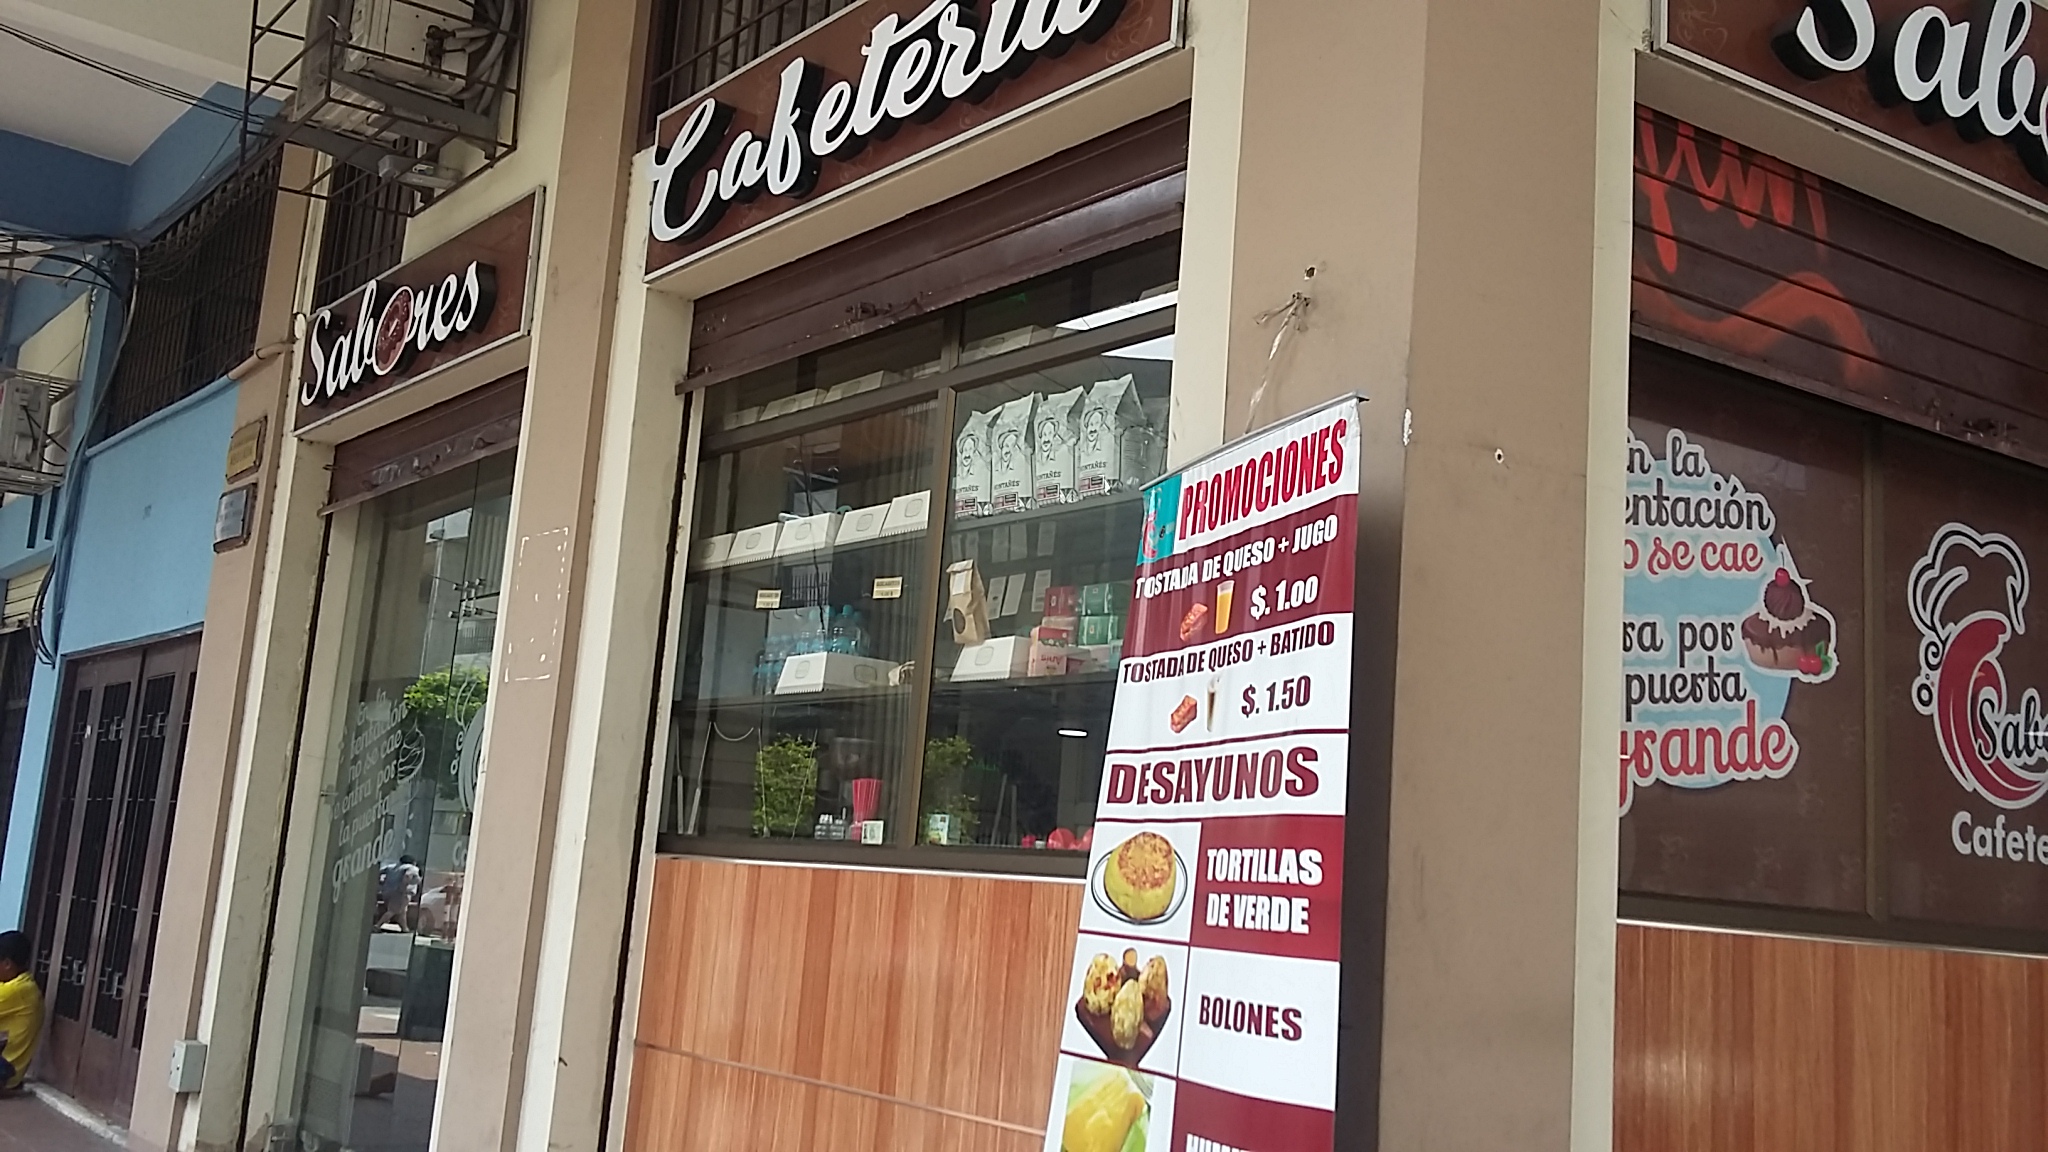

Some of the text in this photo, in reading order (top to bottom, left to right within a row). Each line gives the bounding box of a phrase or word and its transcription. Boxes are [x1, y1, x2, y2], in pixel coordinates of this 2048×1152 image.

[1796, 0, 2048, 156] Sab
[301, 261, 479, 406] Sabores
[1178, 418, 1347, 541] PROMOCIONES
[1672, 436, 1705, 477] la
[1135, 514, 1338, 600] TOSTADA DE QUESO + JUGO
[1648, 537, 1695, 575] se
[1701, 541, 1763, 572] cae
[1275, 576, 1318, 612] 1.00
[1123, 621, 1335, 684] TOSTADA DE QUESO + BATIDO
[1623, 620, 1735, 668] ra por
[1266, 675, 1311, 712] 1.50
[1625, 656, 1747, 722] puerta
[1977, 695, 2048, 761] Sab
[1106, 746, 1319, 805] DESAYUNOS
[333, 817, 396, 904] grande
[1206, 848, 1323, 886] TORTILLAS
[1206, 893, 1310, 935] DE VERDE
[1199, 994, 1303, 1042] BOLONES
